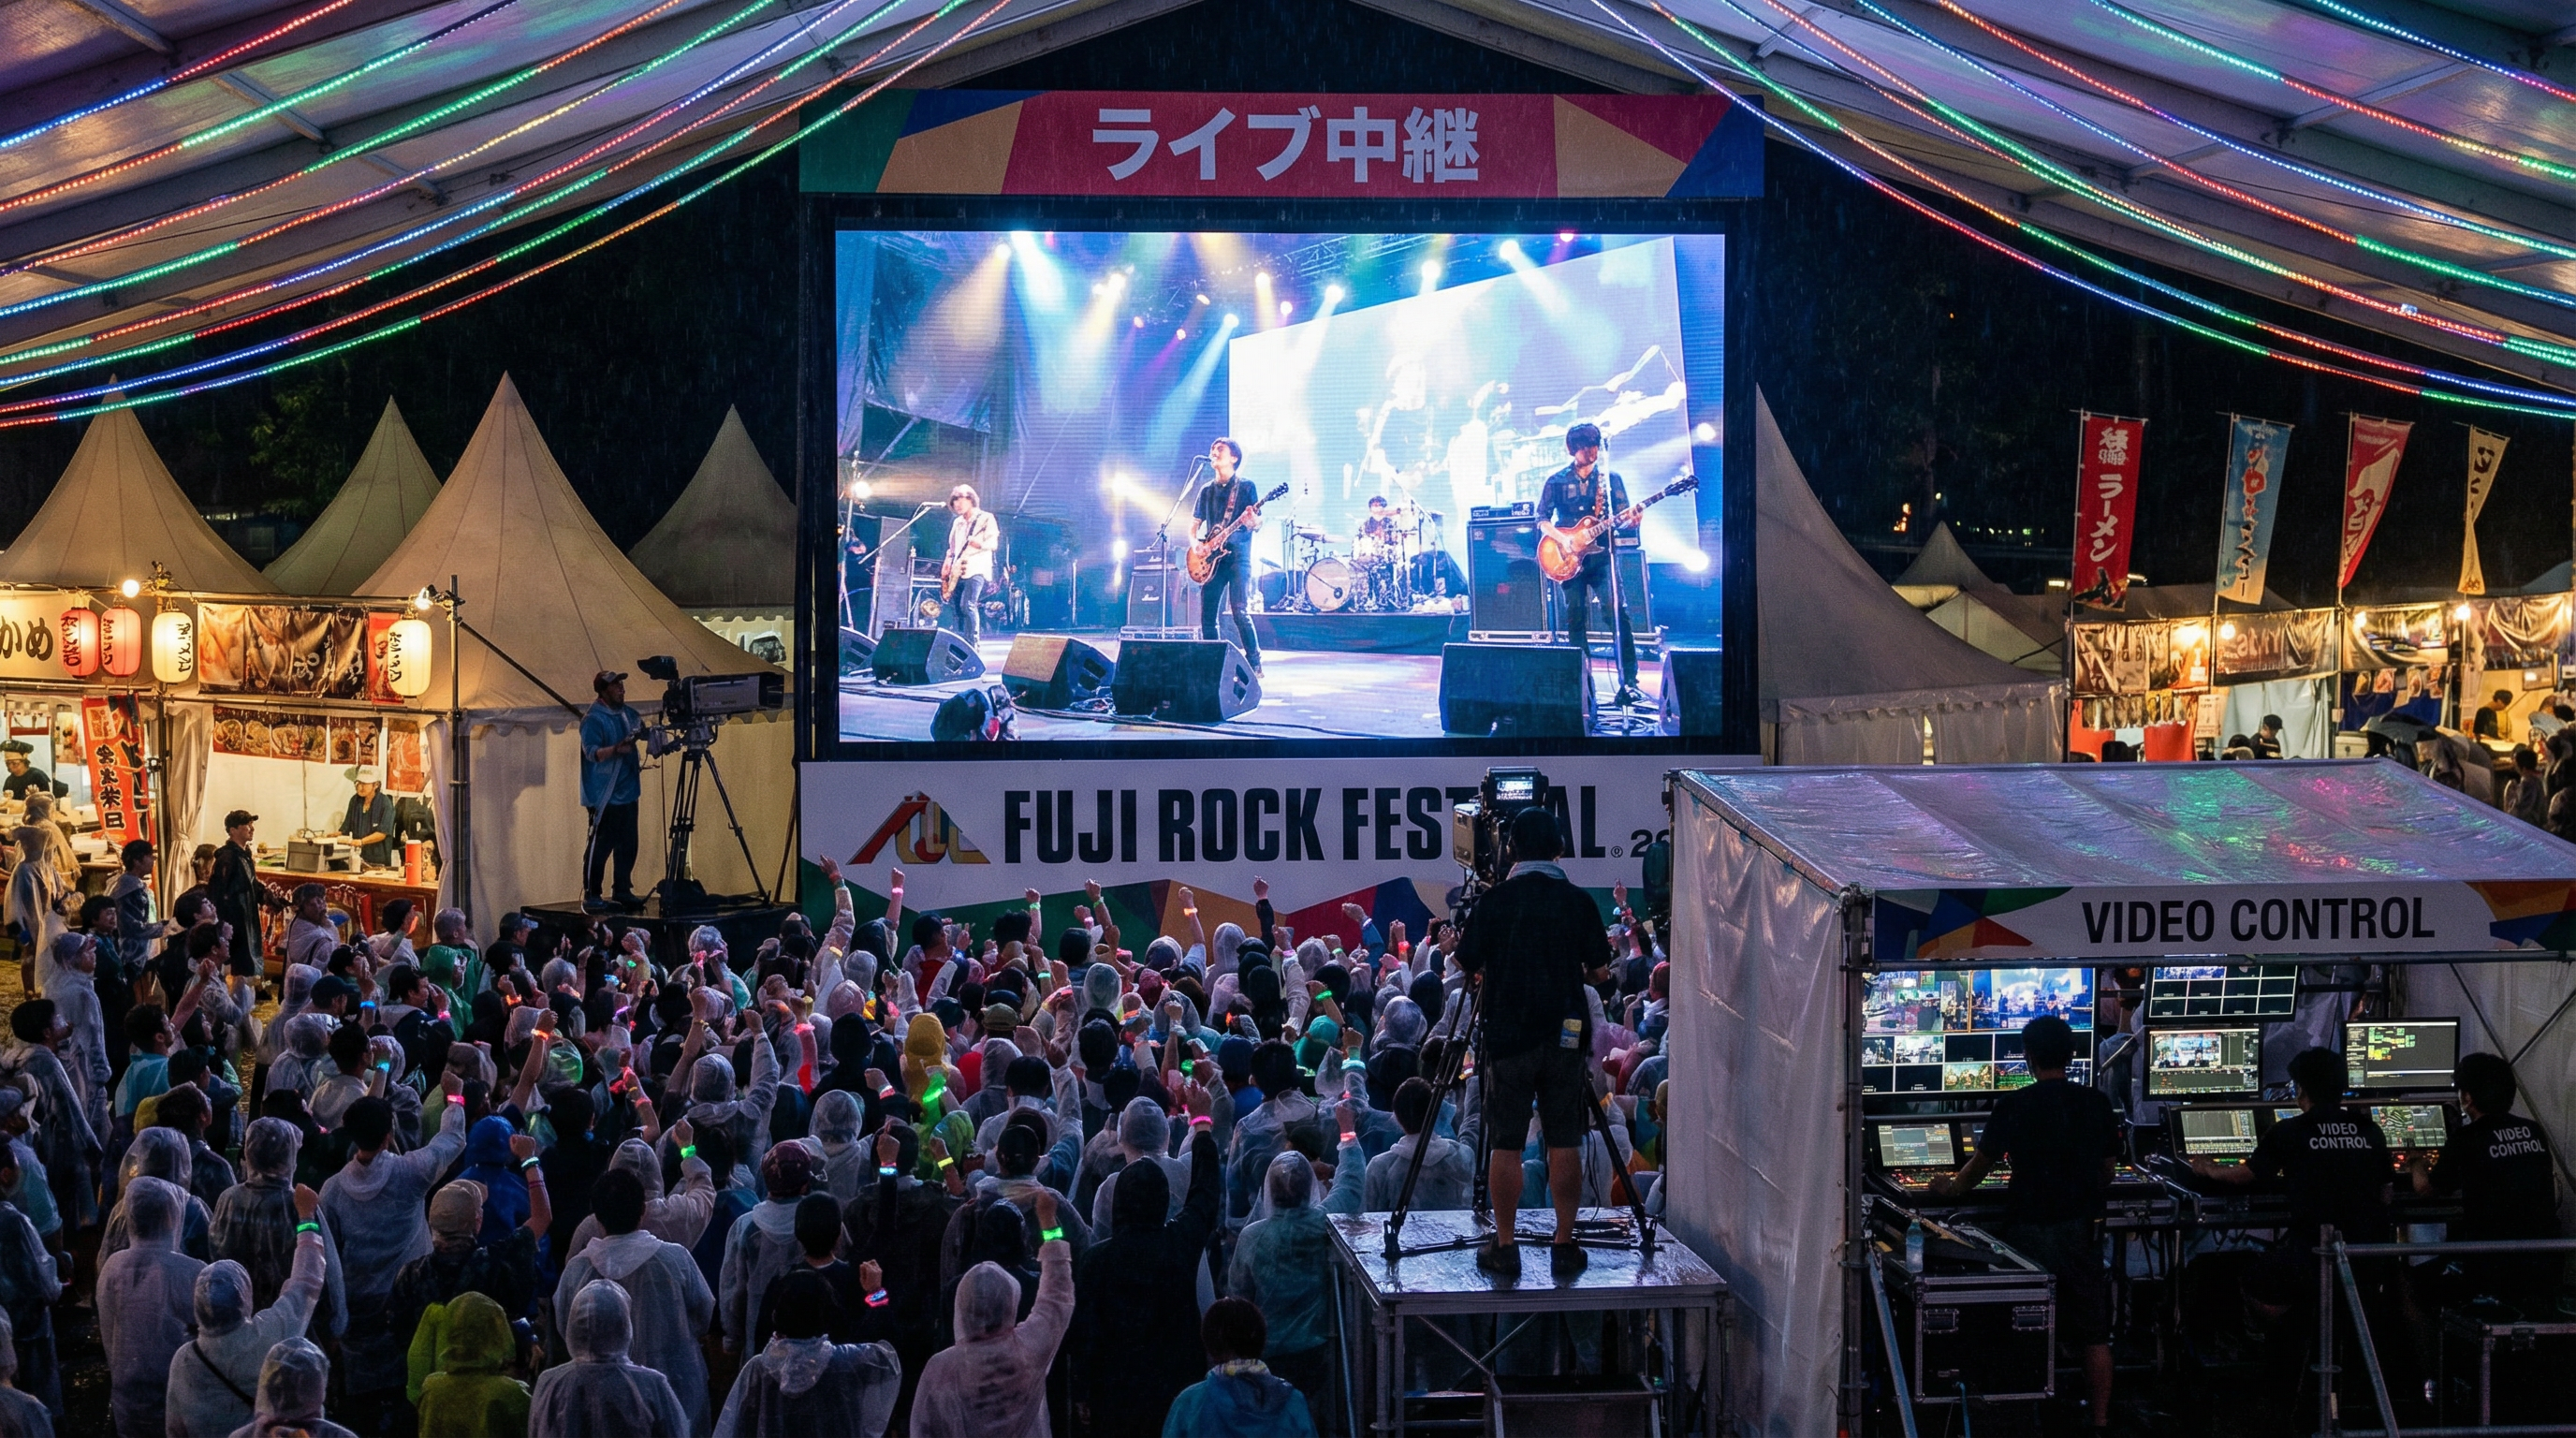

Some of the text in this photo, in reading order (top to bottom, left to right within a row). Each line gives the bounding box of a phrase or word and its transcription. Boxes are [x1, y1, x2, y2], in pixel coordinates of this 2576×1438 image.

[1092, 105, 1480, 183] ライブ中継
[1004, 789, 1136, 863] FUJI
[1159, 787, 1325, 862] ROCK
[2082, 897, 2436, 944] VIDEO CONTROL
[2317, 1123, 2358, 1136] VIDEO
[2493, 1125, 2531, 1142] VIDEO
[2309, 1136, 2373, 1150] CONTROL
[2489, 1138, 2546, 1158] CONTROL
